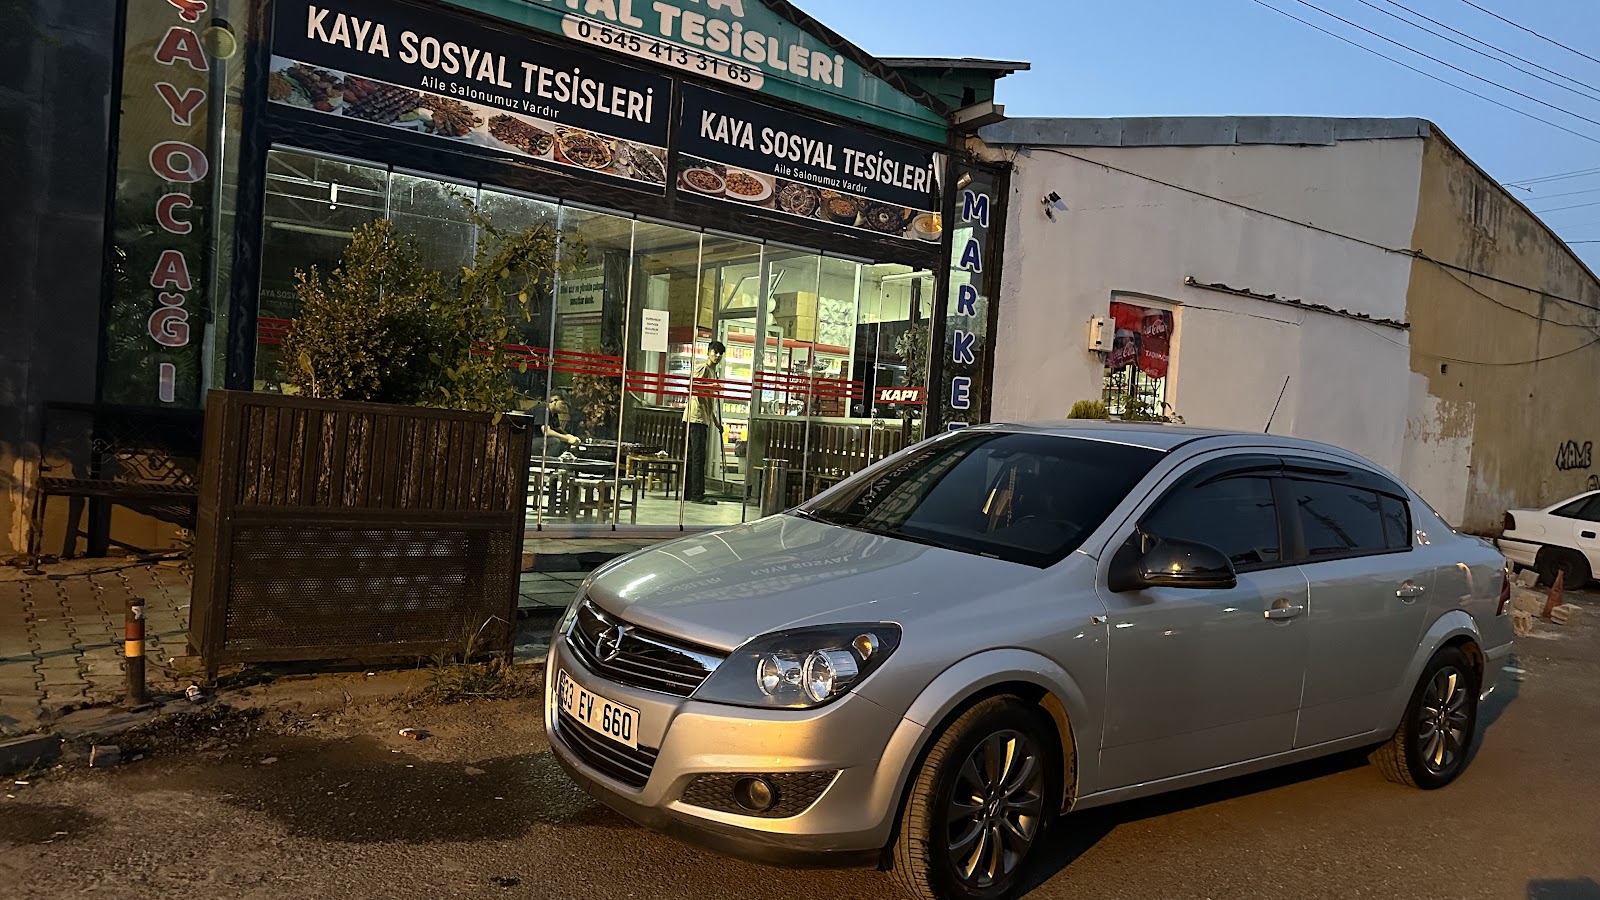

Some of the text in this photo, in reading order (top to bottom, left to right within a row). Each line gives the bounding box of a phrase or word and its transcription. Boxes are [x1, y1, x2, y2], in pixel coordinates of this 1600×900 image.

[307, 5, 653, 124] KAYA SOSYAL TESİSLERİ
[577, 20, 752, 84] 0.545 413 31 65
[652, 2, 845, 88] TESİSLERİ
[421, 75, 560, 119] Aile Salonumuz Vardır
[700, 109, 934, 194] KAYA SOSYAL TESİSLERİ
[774, 162, 868, 194] Aile Salonumuz Vardır
[948, 189, 991, 432] MARKE
[880, 389, 919, 402] KAPI
[578, 690, 595, 724] EV
[602, 703, 632, 741] 660
